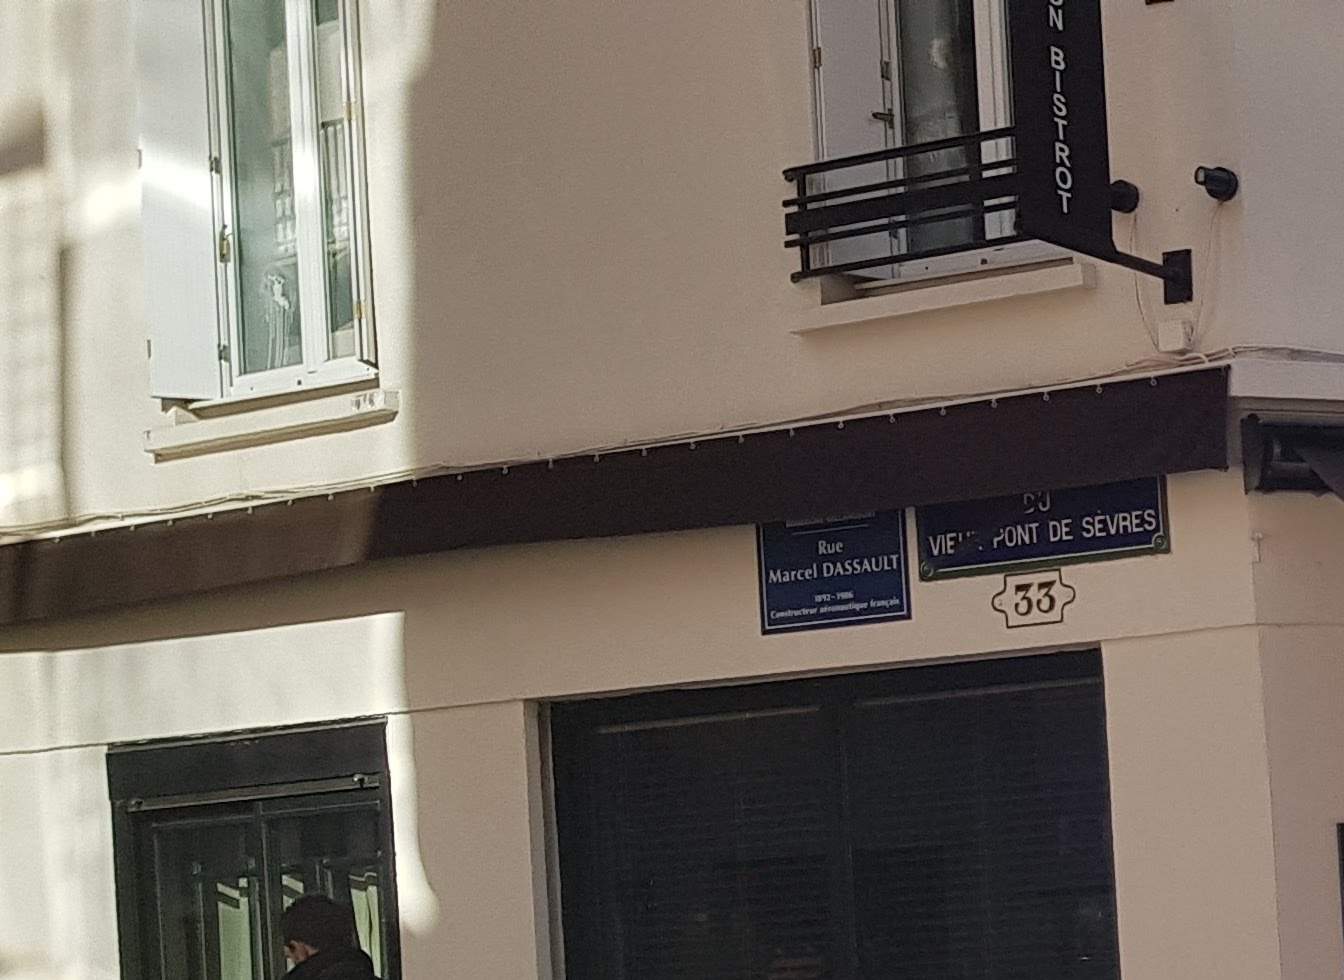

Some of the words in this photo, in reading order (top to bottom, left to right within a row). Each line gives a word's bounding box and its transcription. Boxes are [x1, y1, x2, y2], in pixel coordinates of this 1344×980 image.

[1049, 45, 1074, 215] BISTROT
[816, 540, 845, 556] Rue
[928, 531, 984, 558] VIE
[1048, 518, 1075, 543] DE
[1080, 508, 1158, 539] SÈVRES
[767, 562, 818, 585] Marcel
[821, 553, 900, 578] DASSAULT
[769, 606, 818, 620] Constructeur
[869, 594, 901, 610] français
[1013, 579, 1058, 617] 33
